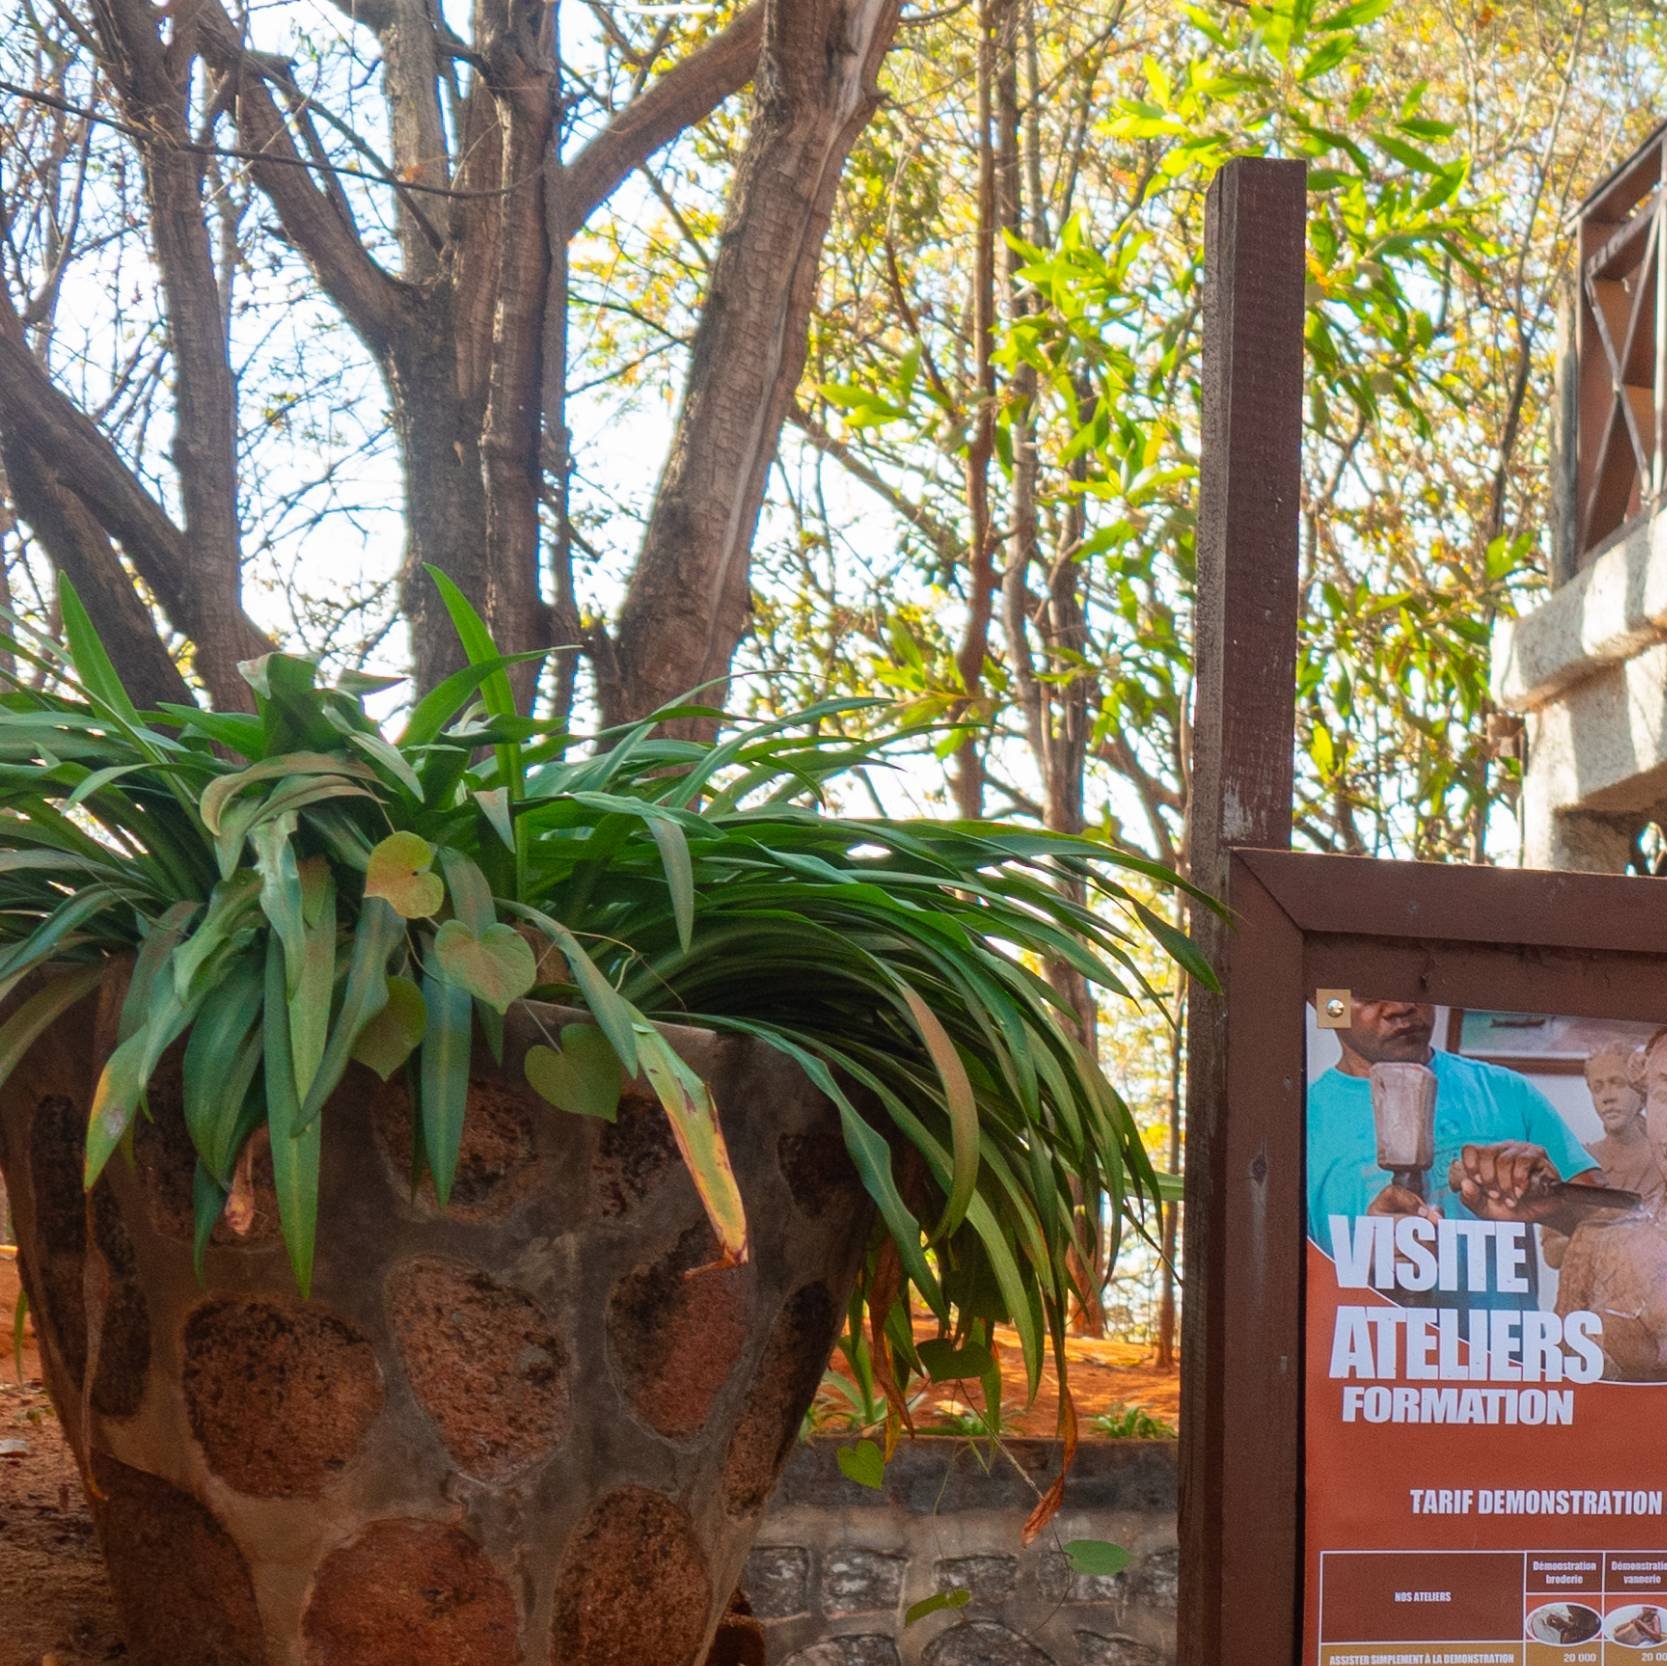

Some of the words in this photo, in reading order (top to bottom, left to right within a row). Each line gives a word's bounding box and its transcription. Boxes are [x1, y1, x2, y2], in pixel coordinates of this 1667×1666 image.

[1328, 1214, 1529, 1293] VISITE
[1329, 1305, 1604, 1384] ATELIERS
[1342, 1386, 1575, 1426] FORMATION
[1410, 1490, 1472, 1513] TARIF
[1478, 1490, 1662, 1514] DEMONSTRATION
